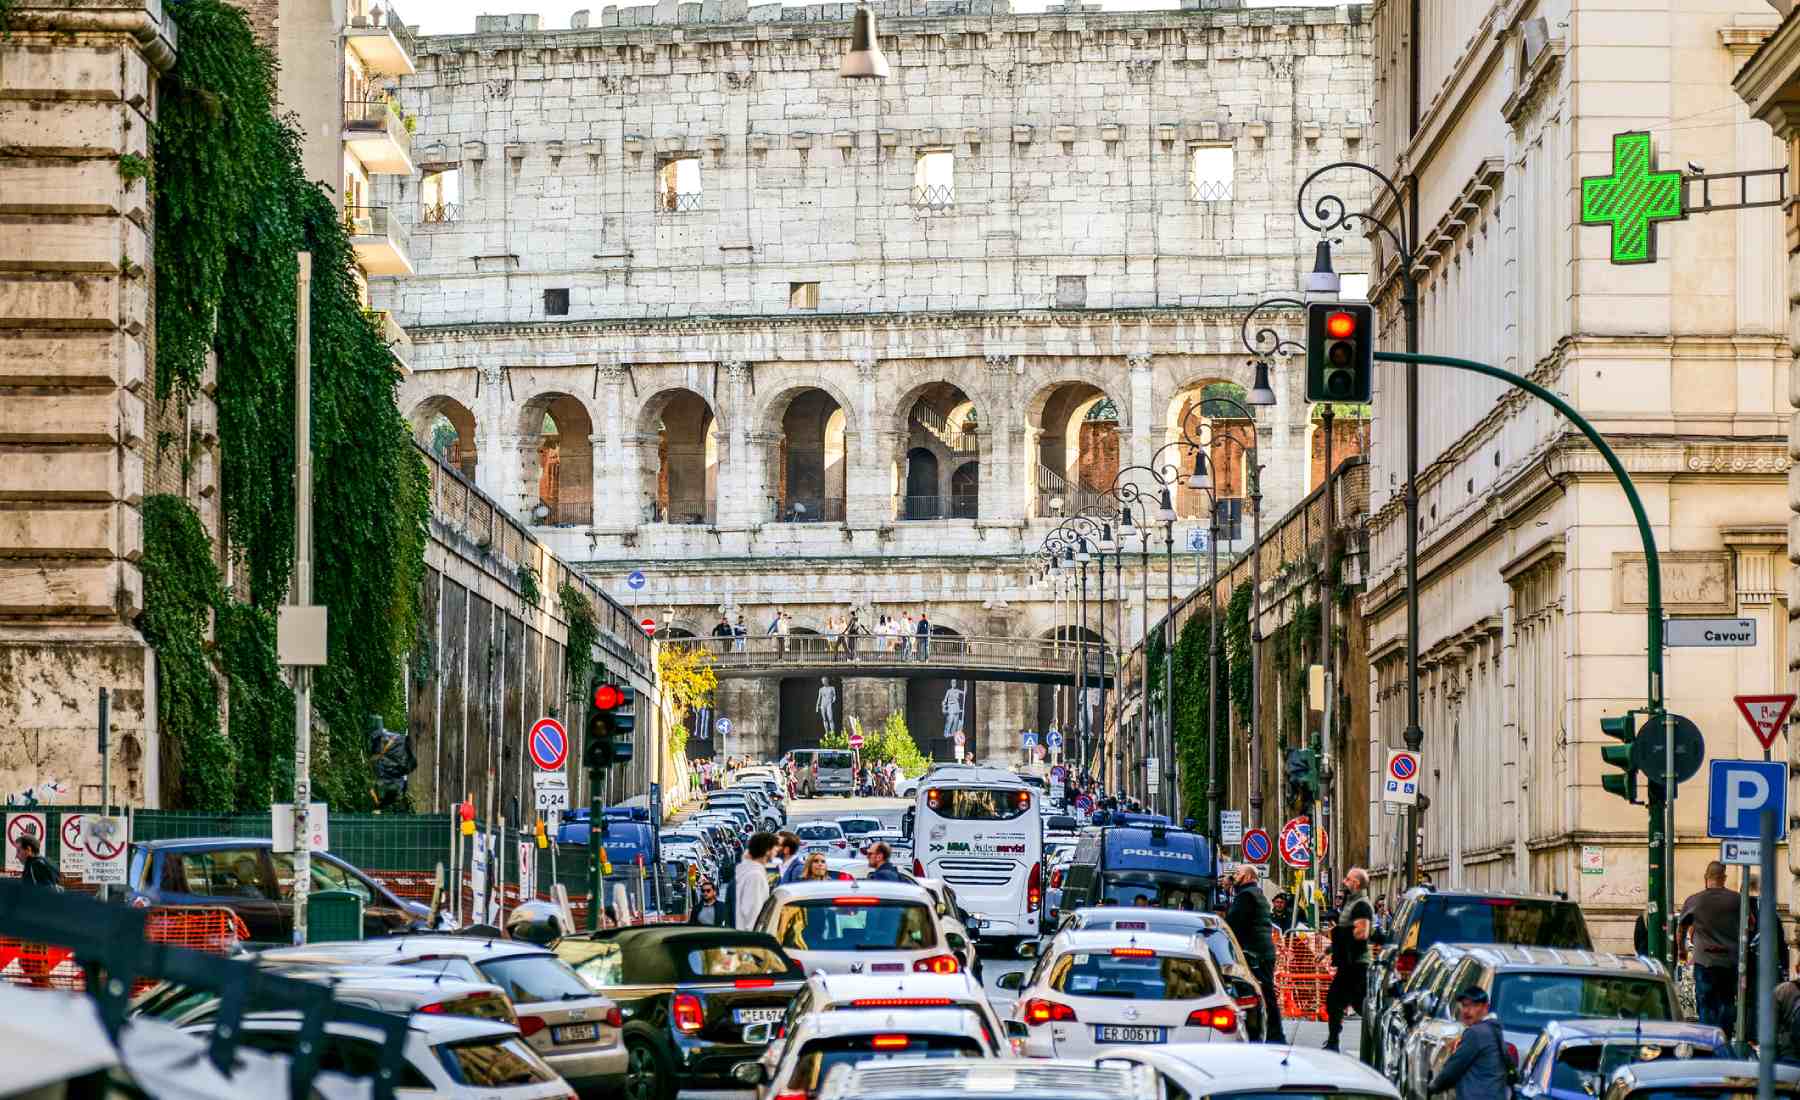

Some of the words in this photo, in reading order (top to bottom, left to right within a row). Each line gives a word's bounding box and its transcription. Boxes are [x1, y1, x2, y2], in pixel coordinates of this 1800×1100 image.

[1704, 630, 1751, 641] Cavour
[1725, 769, 1770, 829] P
[603, 841, 637, 849] IZIA
[1122, 848, 1194, 861] POLIZIA
